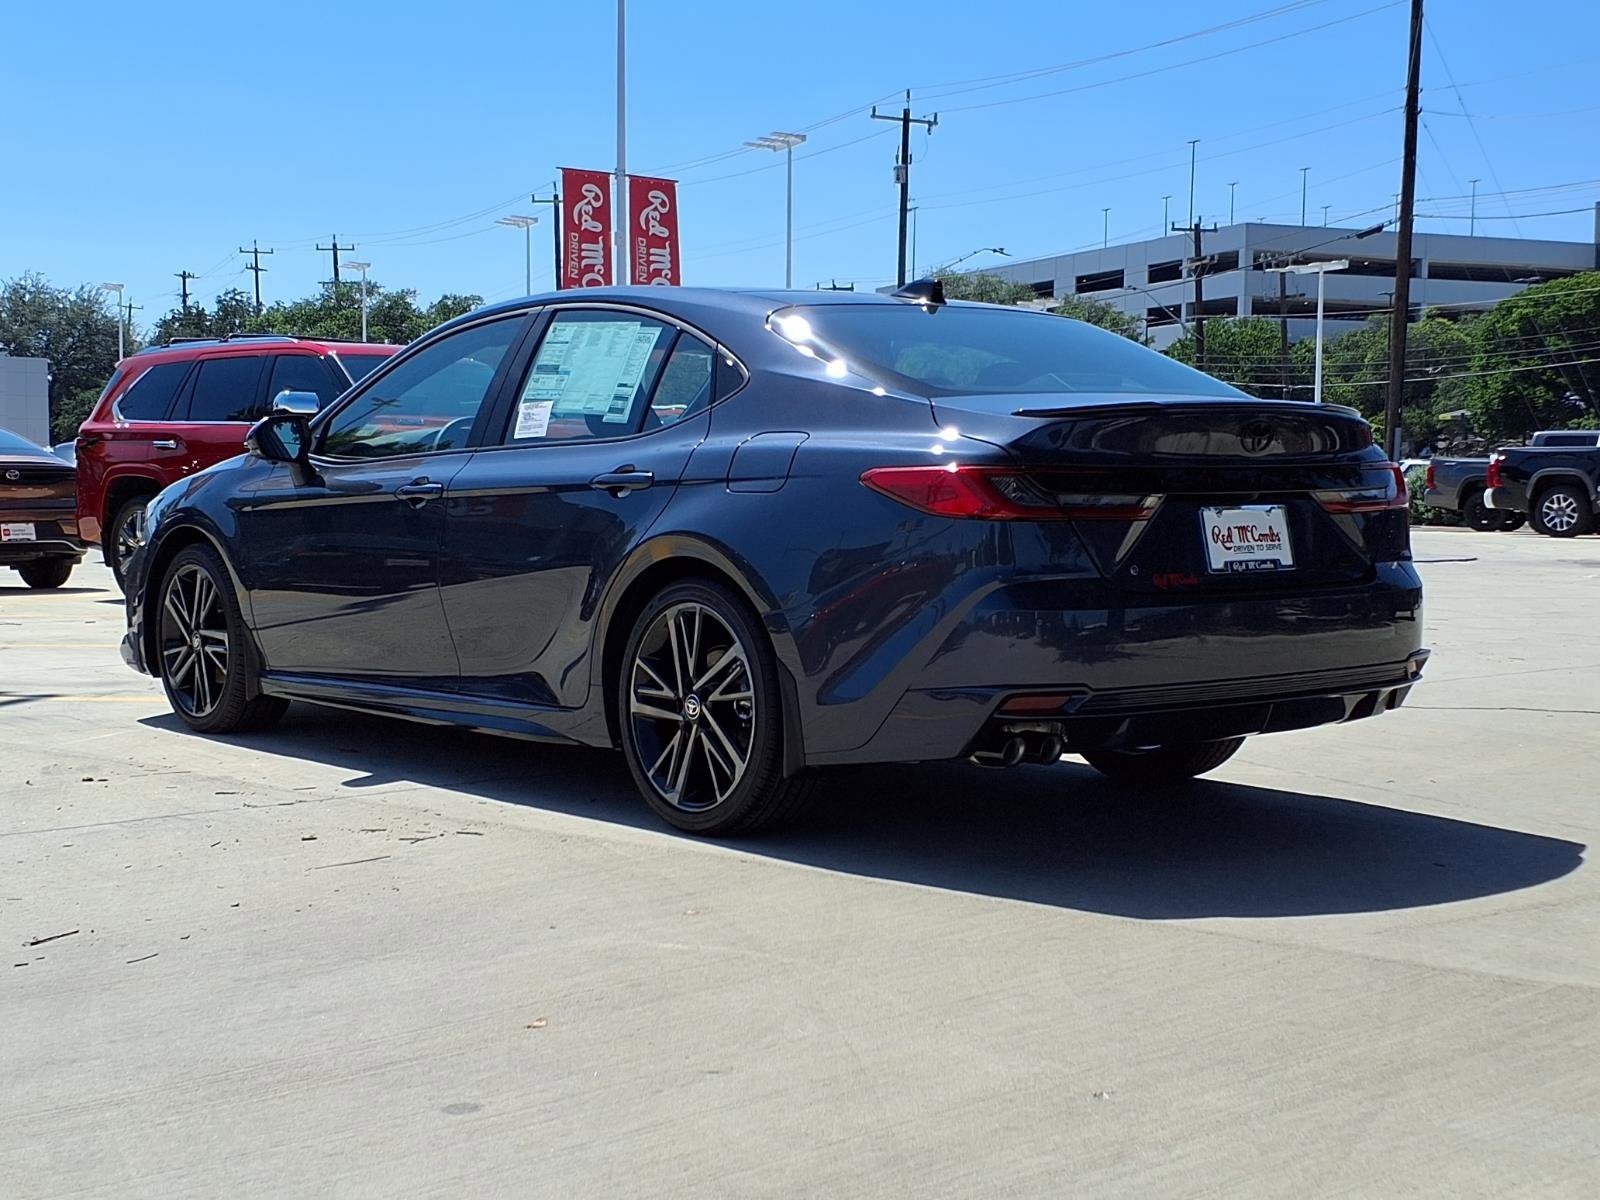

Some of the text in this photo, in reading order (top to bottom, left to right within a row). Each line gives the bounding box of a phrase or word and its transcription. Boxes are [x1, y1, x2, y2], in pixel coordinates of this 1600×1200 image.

[573, 183, 603, 232] Red
[640, 190, 669, 237] Red
[570, 232, 579, 279] DRIVEN
[638, 237, 647, 282] DRIVEN
[1212, 524, 1280, 550] Red McCombs
[1233, 545, 1255, 553] DRIVEN
